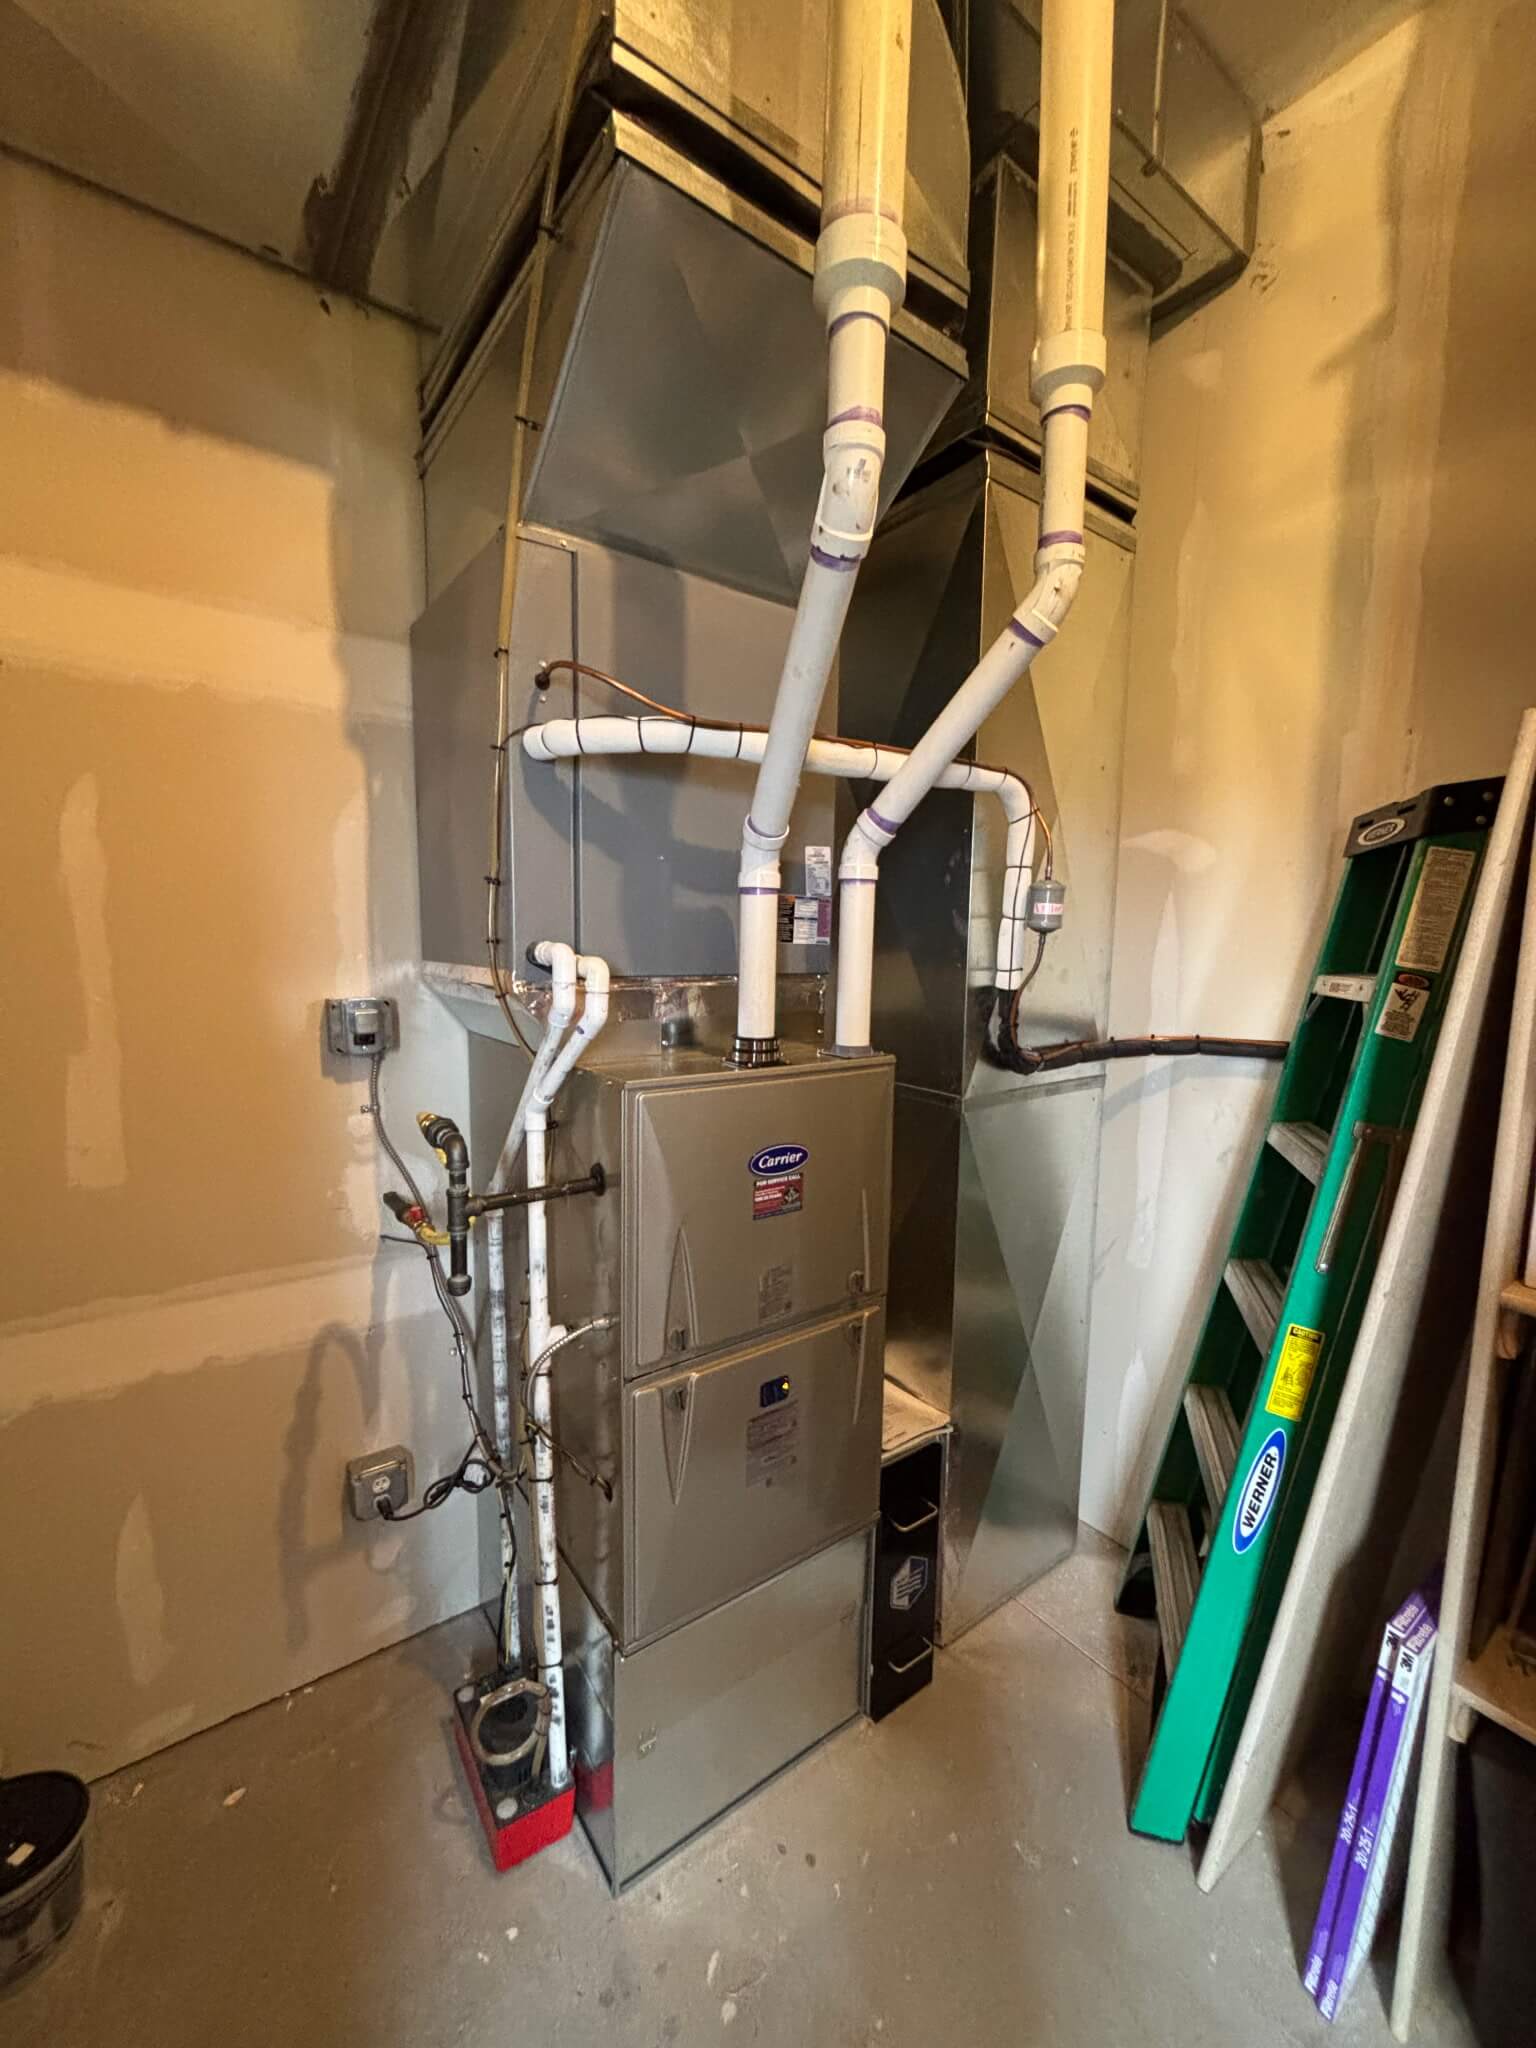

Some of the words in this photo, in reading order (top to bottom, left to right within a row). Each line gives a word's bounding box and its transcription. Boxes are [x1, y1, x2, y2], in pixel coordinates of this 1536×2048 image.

[758, 1152, 802, 1169] Carrier
[1242, 1452, 1277, 1529] WERNER
[1406, 1623, 1433, 1652] Filtrete
[1400, 1652, 1415, 1672] 3M
